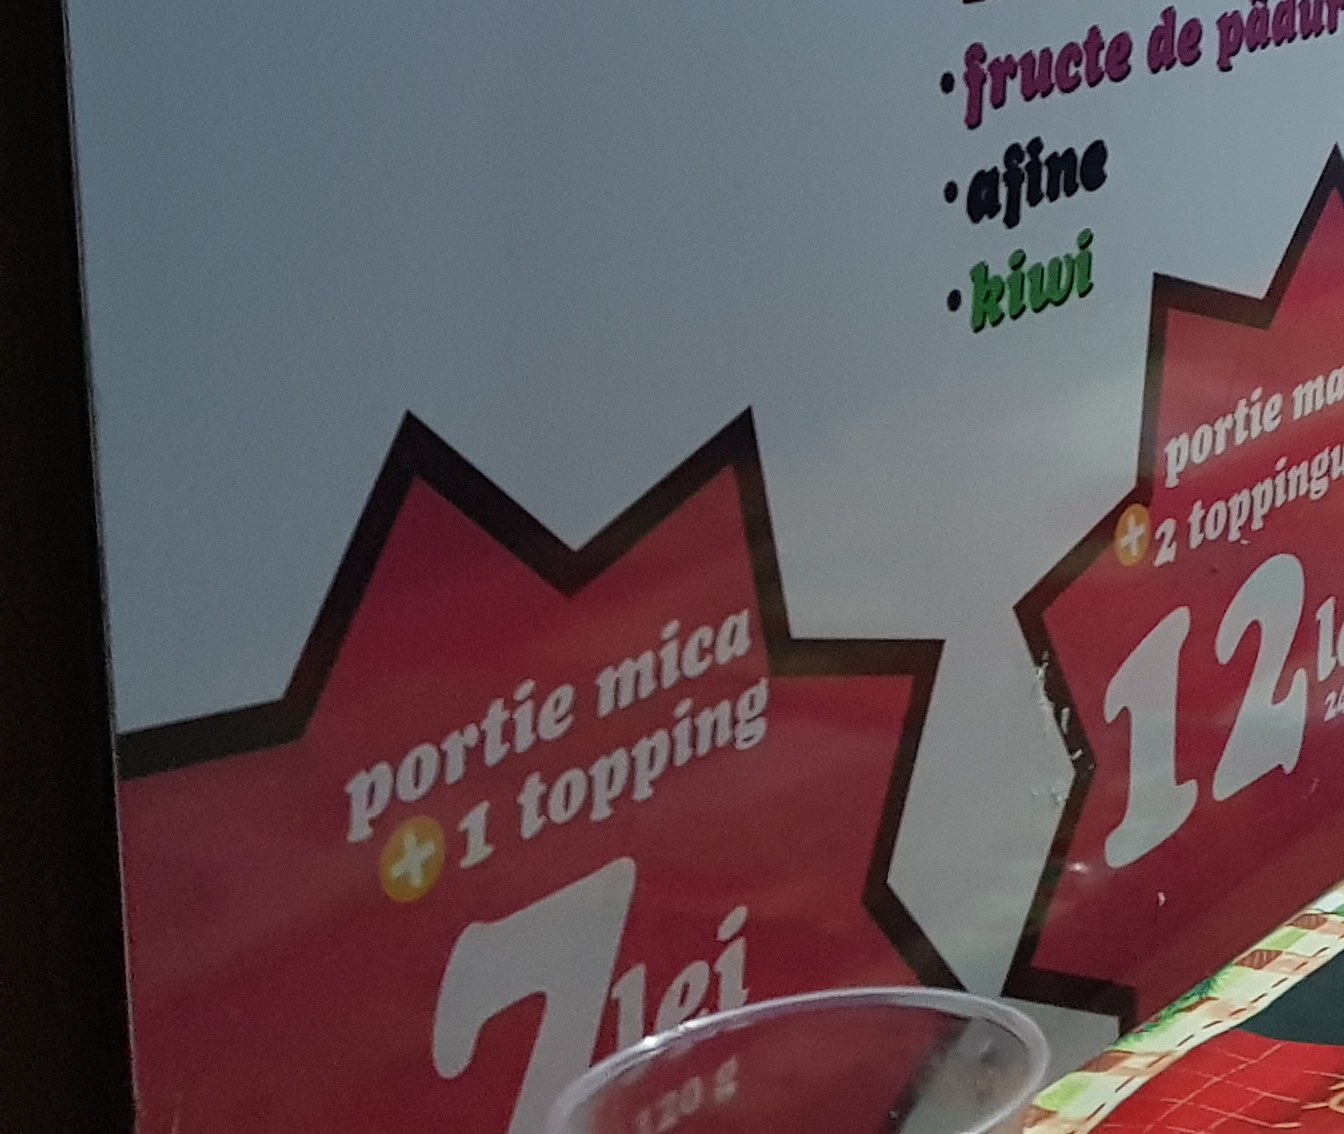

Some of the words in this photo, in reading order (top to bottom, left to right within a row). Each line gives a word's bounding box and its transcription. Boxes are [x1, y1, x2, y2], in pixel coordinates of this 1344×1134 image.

[963, 24, 1134, 130] fructe
[1146, 5, 1203, 74] de
[966, 136, 1109, 229] afine
[969, 227, 1094, 334] kiwi
[1163, 386, 1283, 489] portie
[1153, 517, 1178, 567] 2
[345, 678, 576, 844] portie
[595, 607, 754, 717] mica
[458, 800, 495, 870] 1
[517, 676, 770, 841] topping
[1104, 552, 1308, 869] 12
[610, 905, 750, 1050] lei
